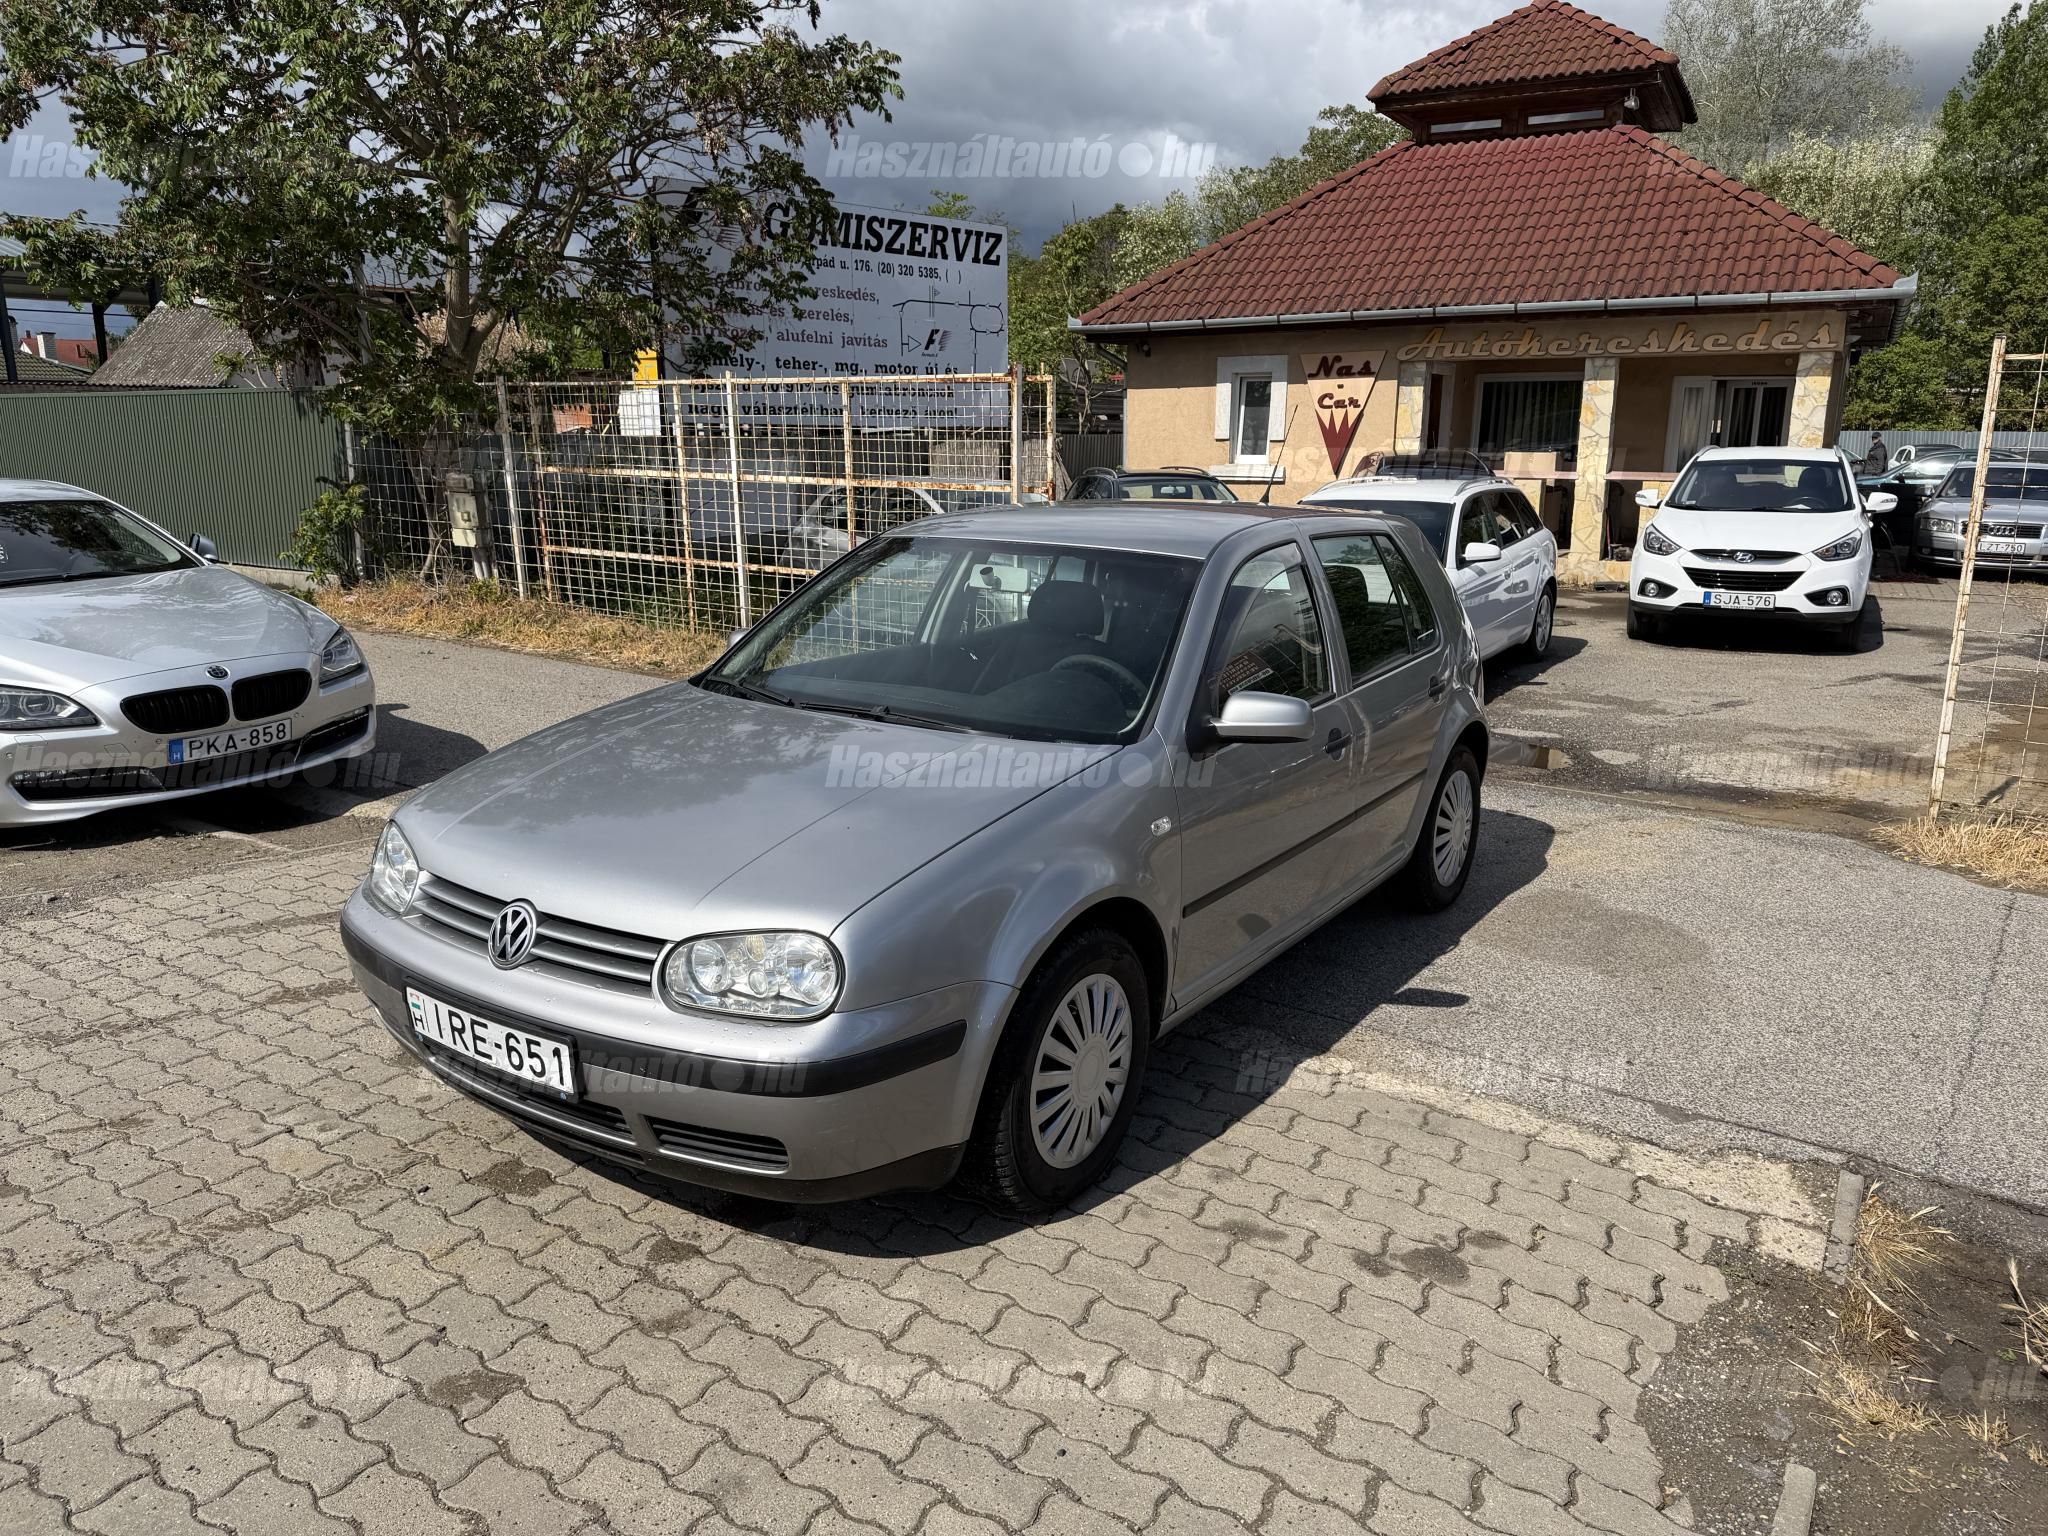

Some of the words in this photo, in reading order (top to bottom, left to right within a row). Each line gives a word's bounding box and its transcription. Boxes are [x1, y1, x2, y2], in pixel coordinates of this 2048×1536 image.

[854, 259, 874, 273] 176.
[877, 262, 896, 278] (20)
[898, 264, 914, 277] 320
[918, 266, 942, 281] 5385,
[776, 329, 833, 345] alufelni
[840, 333, 888, 349] javítás
[1397, 320, 1838, 361] Autókereskedés
[776, 357, 828, 374] teher-,
[835, 361, 867, 376] mg.,
[875, 363, 918, 376] motor
[1307, 355, 1376, 378] Nas
[1713, 594, 1772, 607] SJA-576
[188, 722, 287, 758] PKA-858
[412, 1011, 425, 1031] H
[435, 1003, 564, 1086] IRE-651
